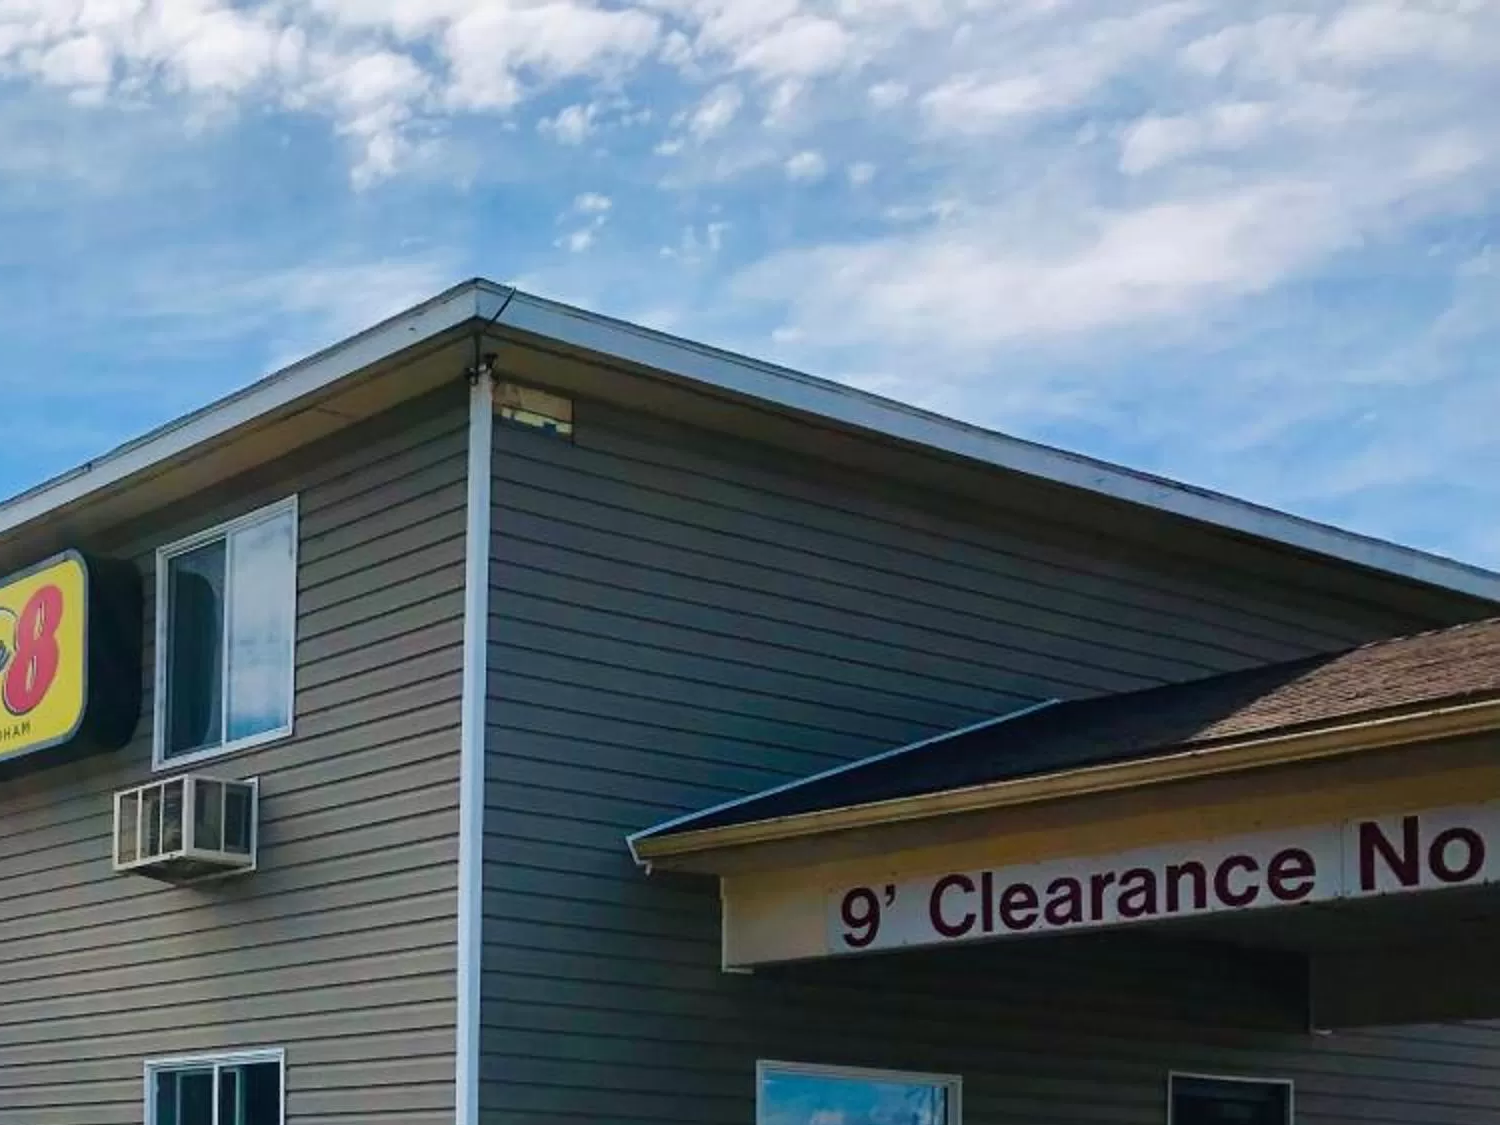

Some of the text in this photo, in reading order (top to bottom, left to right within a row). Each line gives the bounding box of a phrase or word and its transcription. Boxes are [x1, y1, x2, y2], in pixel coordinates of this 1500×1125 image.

[3, 585, 63, 714] 8
[929, 846, 1317, 939] Clearance
[1359, 815, 1485, 891] No
